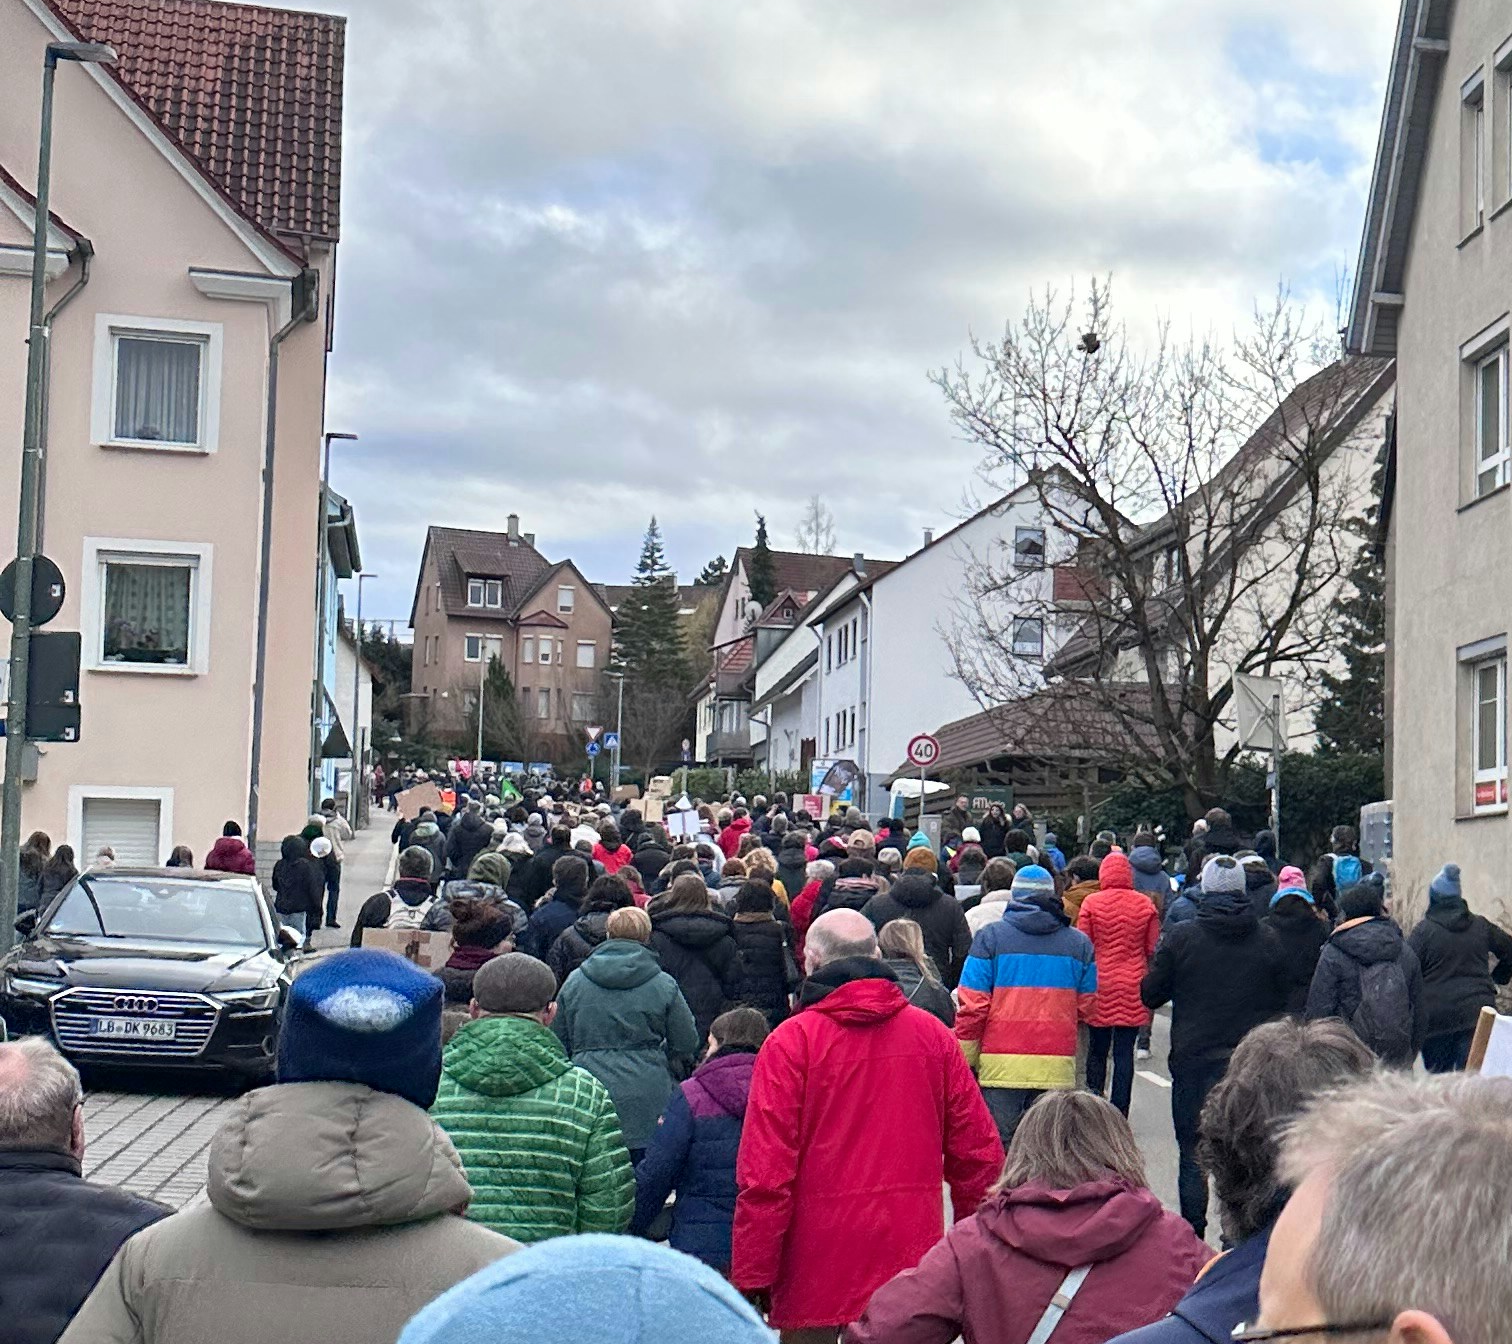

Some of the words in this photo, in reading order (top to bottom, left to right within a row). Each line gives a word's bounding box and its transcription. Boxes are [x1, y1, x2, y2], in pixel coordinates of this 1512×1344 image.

[914, 743, 933, 758] 40
[99, 1021, 115, 1033] LB
[124, 1022, 140, 1034] DK
